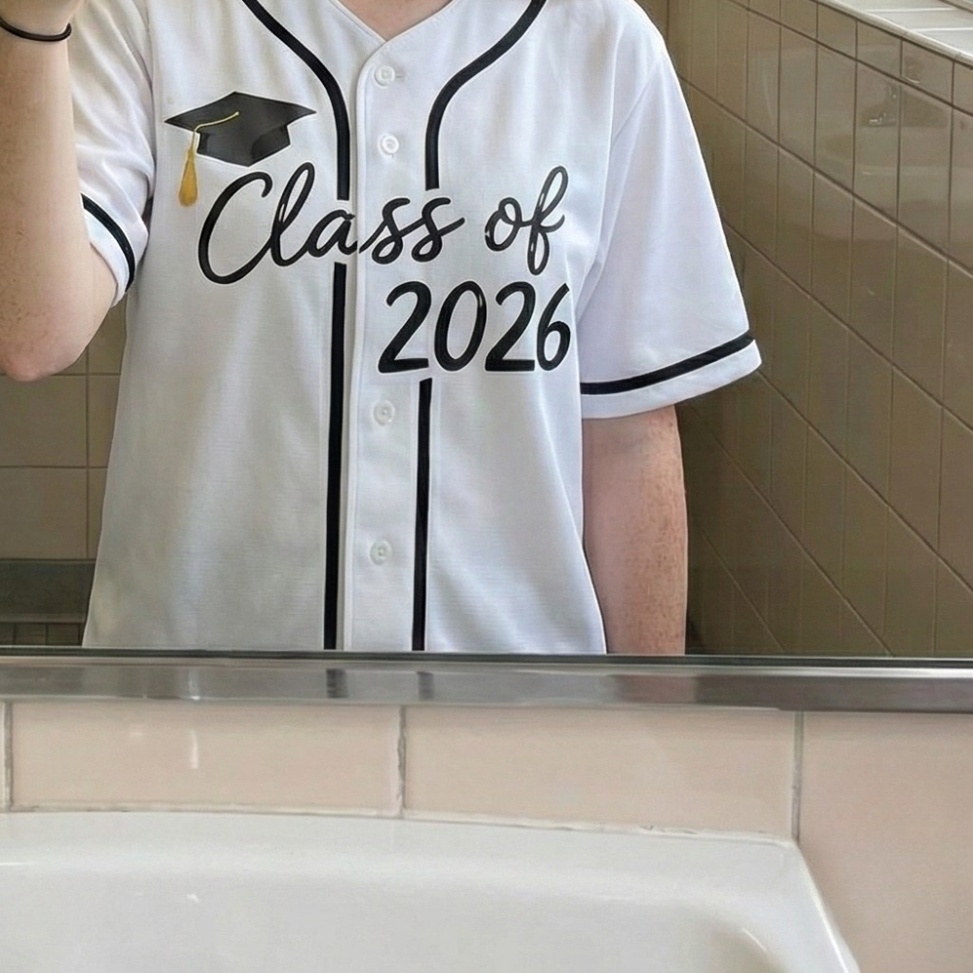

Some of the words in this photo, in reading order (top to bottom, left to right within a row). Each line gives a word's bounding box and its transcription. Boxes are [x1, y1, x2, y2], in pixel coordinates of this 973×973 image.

[198, 162, 465, 284] Class
[484, 165, 569, 275] of
[377, 280, 572, 373] 2026
